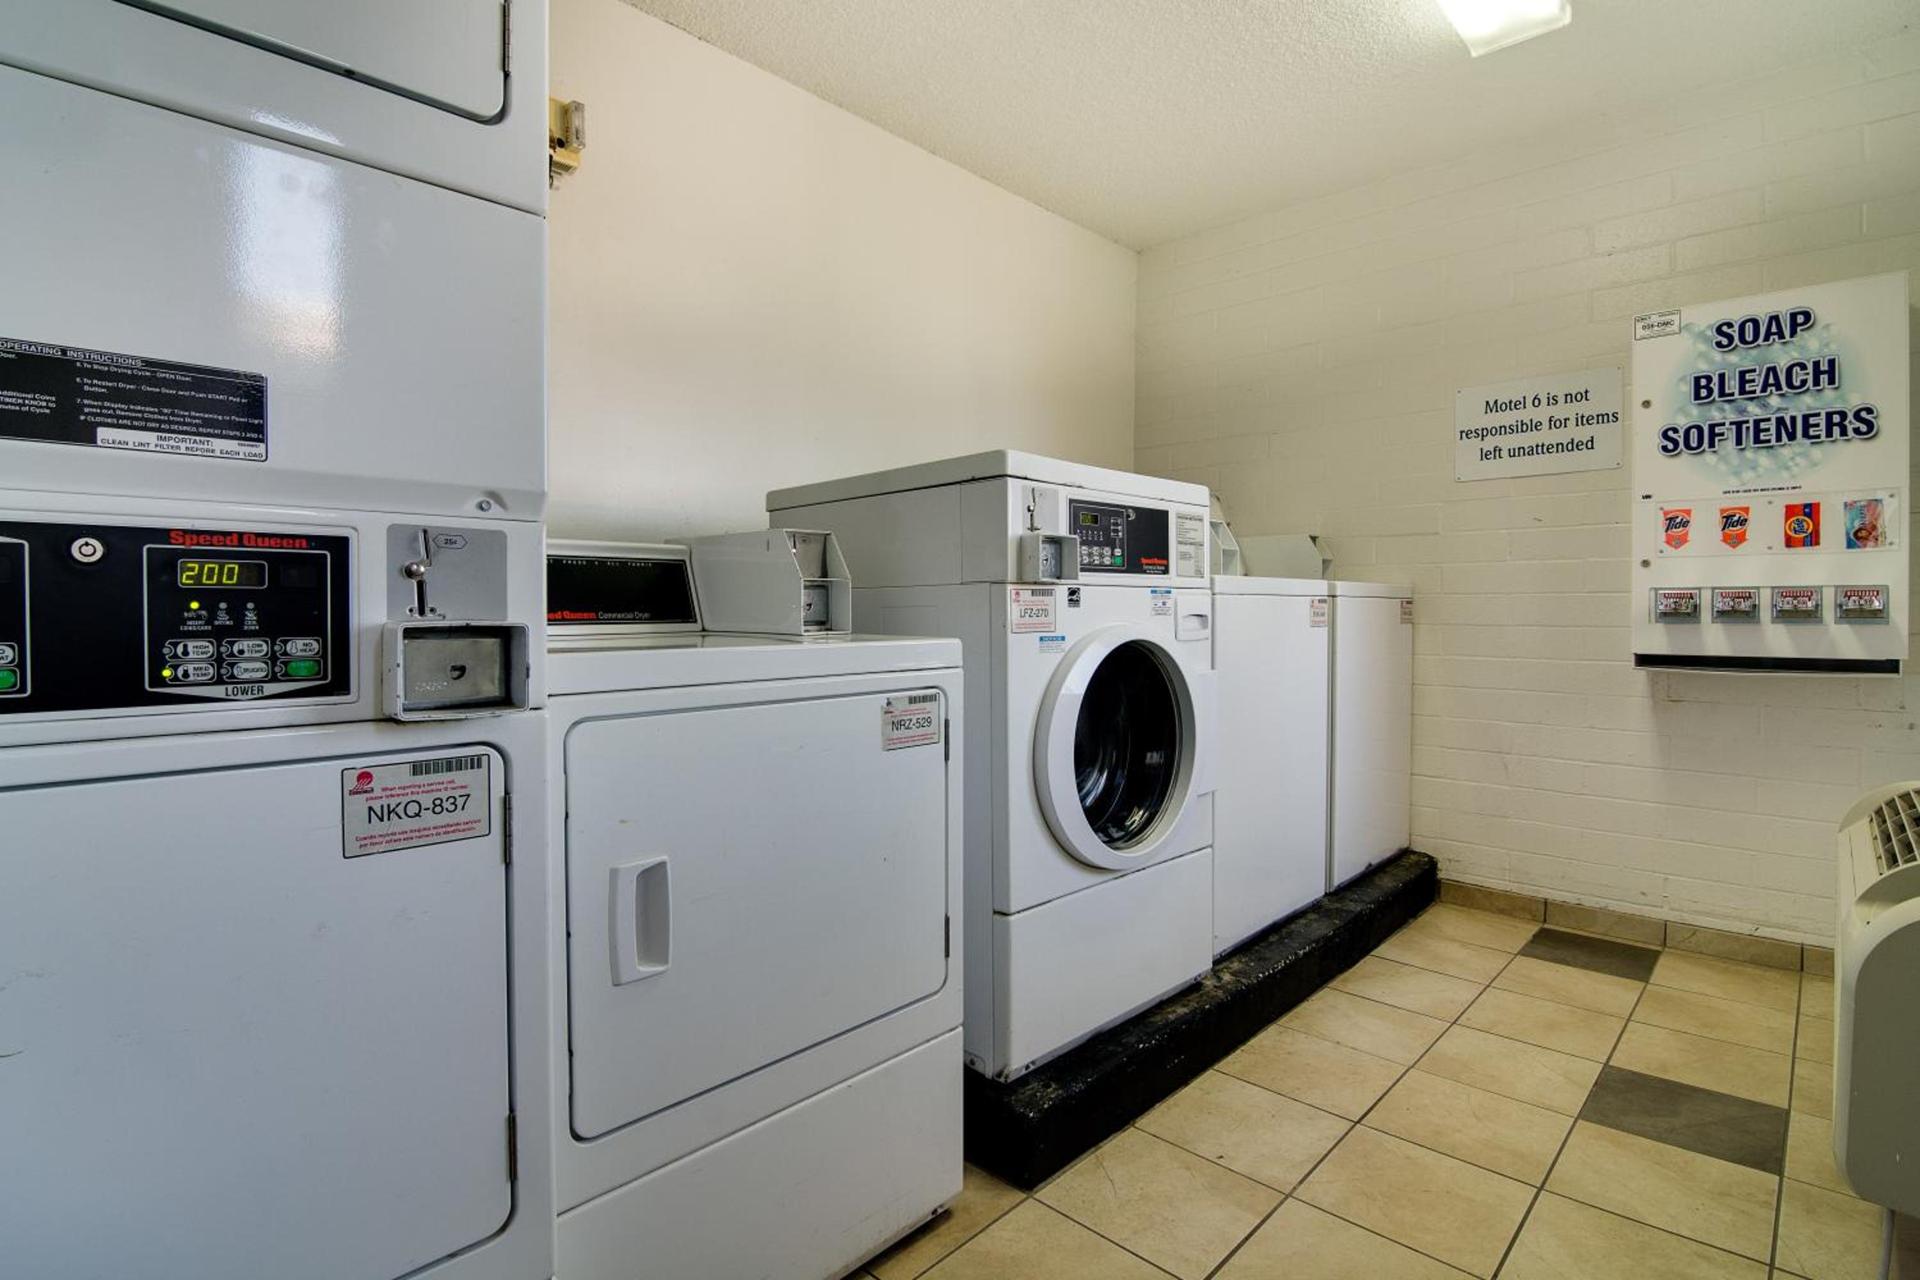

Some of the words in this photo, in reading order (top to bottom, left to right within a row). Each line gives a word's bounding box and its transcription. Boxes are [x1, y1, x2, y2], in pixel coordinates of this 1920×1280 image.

[1713, 307, 1814, 352] SOAP
[1692, 356, 1838, 402] BLEACH
[1484, 396, 1526, 414] Motel
[1532, 394, 1541, 408] 6
[1546, 392, 1558, 406] is
[1564, 388, 1590, 404] not
[1459, 419, 1543, 442] responsible
[1548, 416, 1570, 430] for
[1575, 411, 1619, 427] items
[1660, 406, 1877, 454] SOFTENERS
[100, 438, 129, 447] CLEAN
[154, 443, 181, 451] FILTER
[185, 445, 216, 454] BEFORE
[220, 448, 240, 456] EACH
[244, 450, 264, 459] LOAD
[156, 435, 214, 447] IMPORTANT:
[1480, 445, 1504, 461] left
[1508, 436, 1595, 458] unattended
[1664, 516, 1690, 533] Tide
[1721, 514, 1748, 532] Tide
[168, 530, 238, 548] Speed
[242, 532, 308, 548] Queen
[182, 564, 239, 584] 200
[1020, 608, 1049, 618] LFZ-270
[225, 685, 265, 697] LOWER
[892, 716, 932, 732] NRZ-529
[368, 794, 471, 824] NKQ-837
